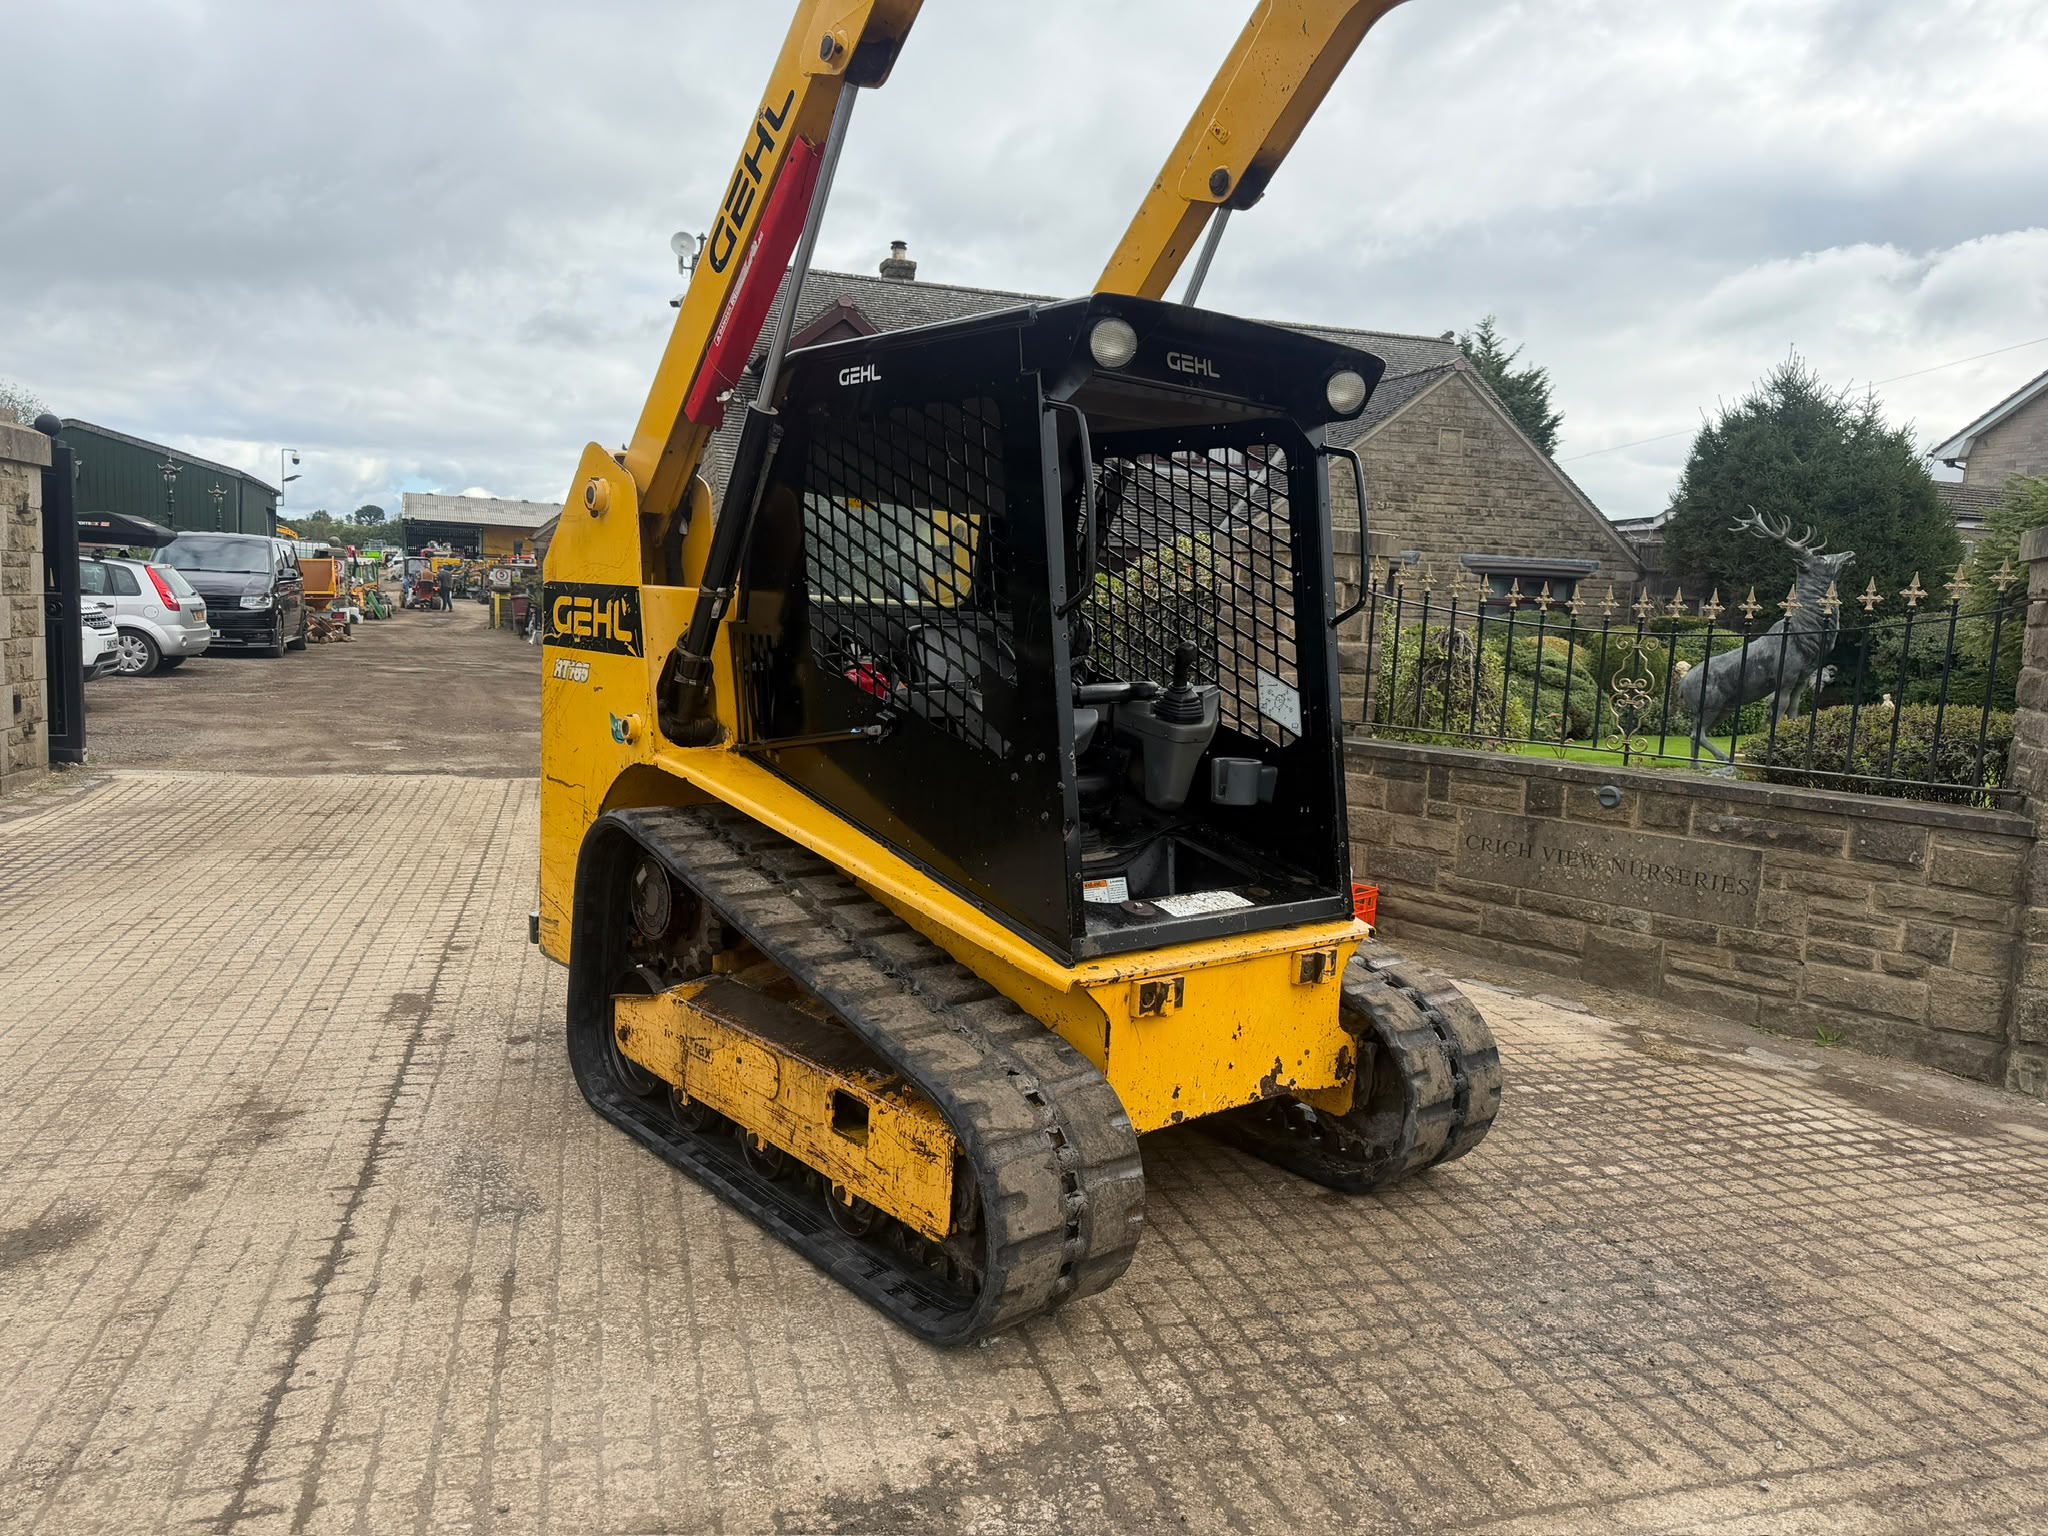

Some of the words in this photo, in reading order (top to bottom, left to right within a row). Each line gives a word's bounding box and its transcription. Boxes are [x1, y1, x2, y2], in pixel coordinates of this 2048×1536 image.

[709, 89, 795, 273] GEHL
[838, 363, 882, 386] GEHL
[1166, 352, 1221, 379] GEHL
[553, 595, 633, 642] GEHL
[1466, 834, 1532, 859] CRICH
[1542, 846, 1600, 870] VIEW
[1608, 857, 1751, 897] NURSERIES
